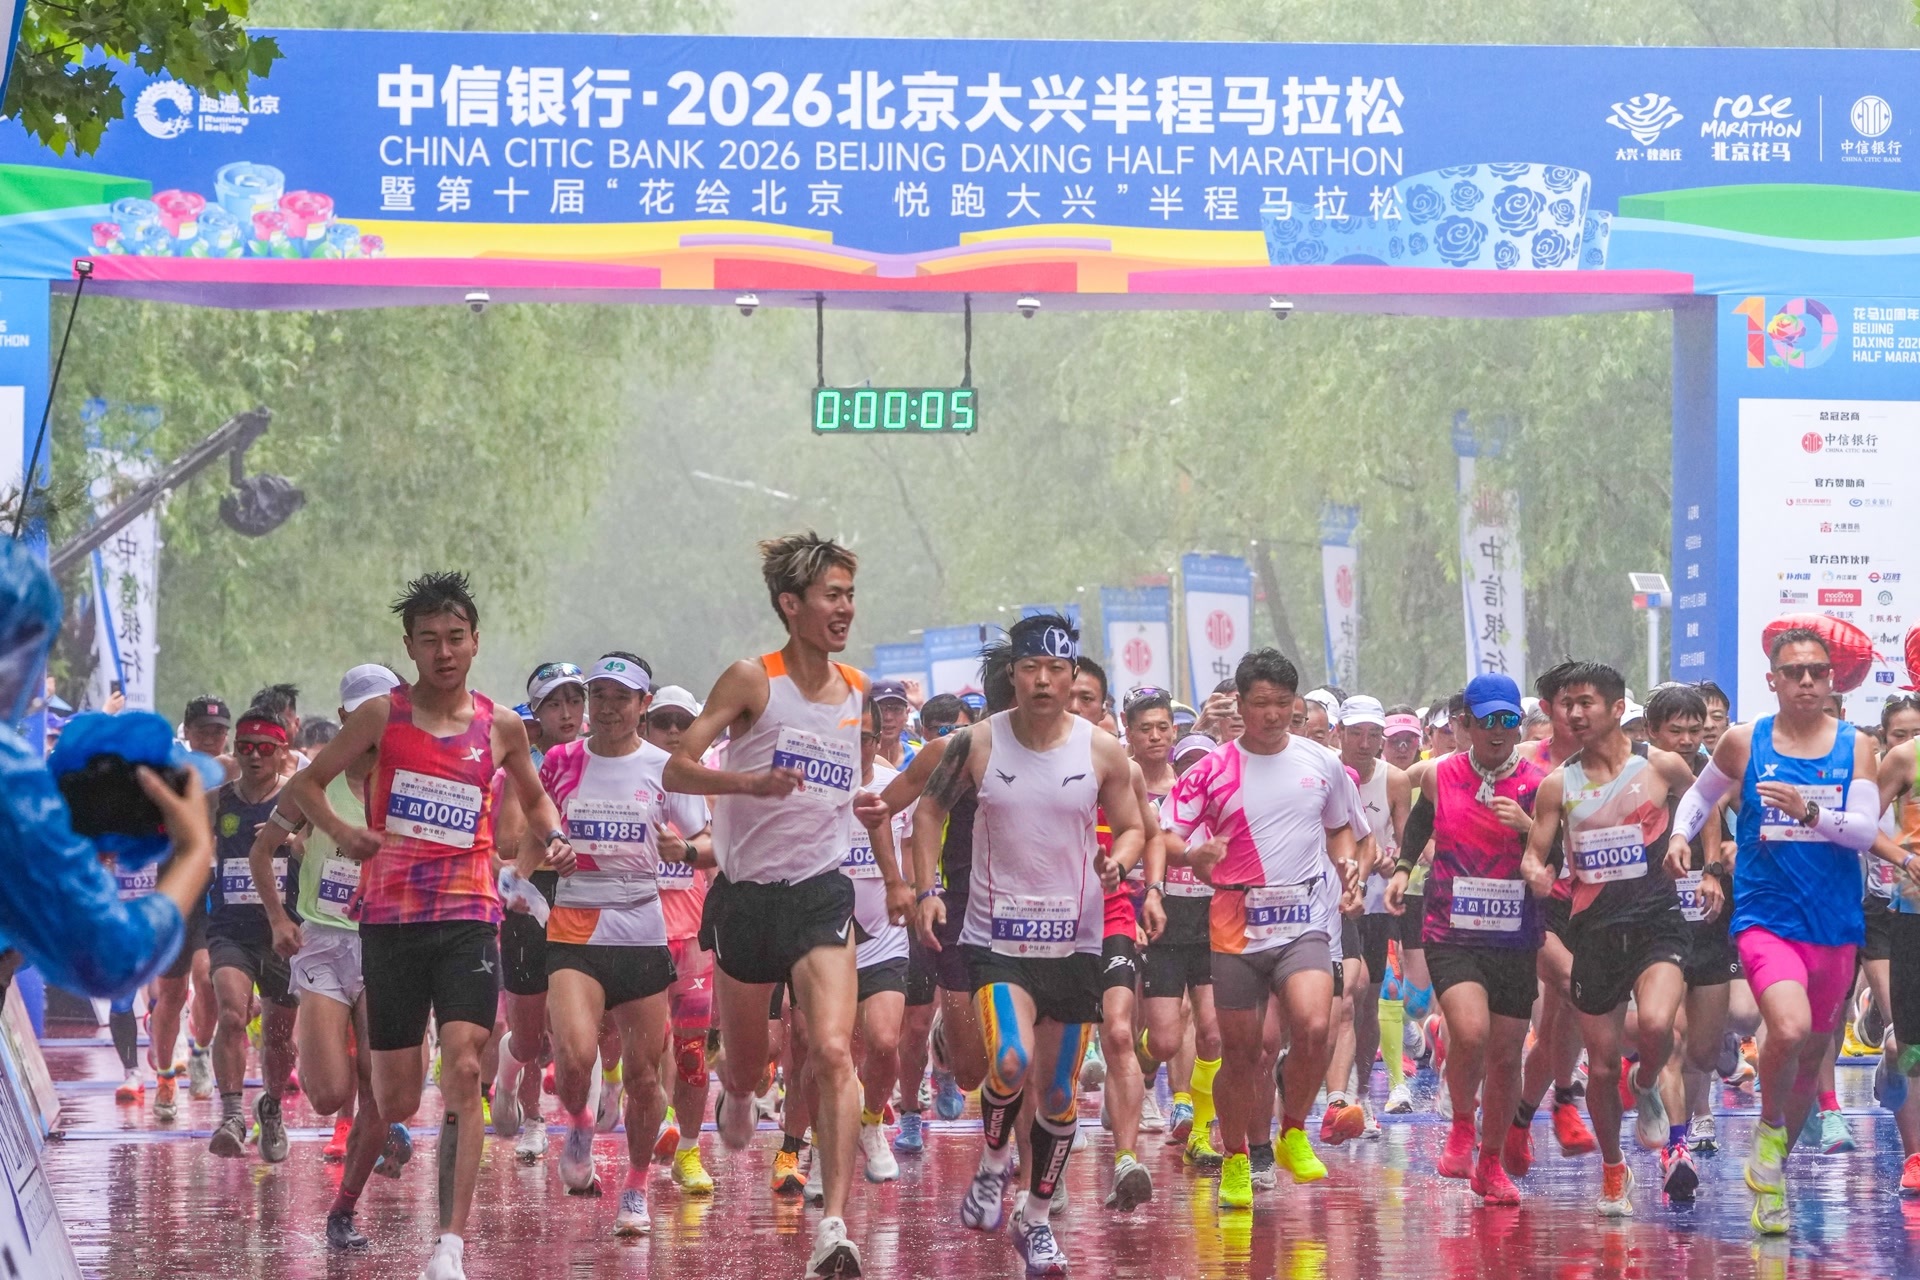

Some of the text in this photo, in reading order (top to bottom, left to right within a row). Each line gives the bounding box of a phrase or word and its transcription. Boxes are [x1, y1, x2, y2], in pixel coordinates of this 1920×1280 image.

[377, 63, 1405, 137] 中信银行·2026北京大兴半程马拉松
[1712, 93, 1794, 119] rose
[205, 114, 249, 126] Running
[205, 123, 244, 134] Beijing
[1700, 119, 1802, 139] MARATHON
[379, 134, 1403, 177] CHINA CITIC BANK 2026 BEIJING DAXING HALF MARATHON
[1711, 141, 1791, 162] 北京花马
[1840, 139, 1902, 156] 中信银行
[1853, 322, 1893, 335] BEIJING
[1853, 336, 1920, 349] DAXING 202
[1853, 350, 1882, 363] HALF
[816, 390, 973, 429] 0:00:05
[1819, 411, 1860, 421] 总冠名商
[1824, 432, 1879, 447] 中信银行
[1814, 477, 1865, 488] 官方赞助商
[1808, 554, 1870, 565] 官方合作伙伴
[807, 760, 852, 788] 0003
[424, 802, 477, 830] 0005
[598, 822, 641, 840] 1985
[1597, 845, 1643, 866] 0009
[1273, 904, 1309, 921] 1713
[1482, 900, 1521, 916] 1033
[1026, 920, 1074, 939] 2858
